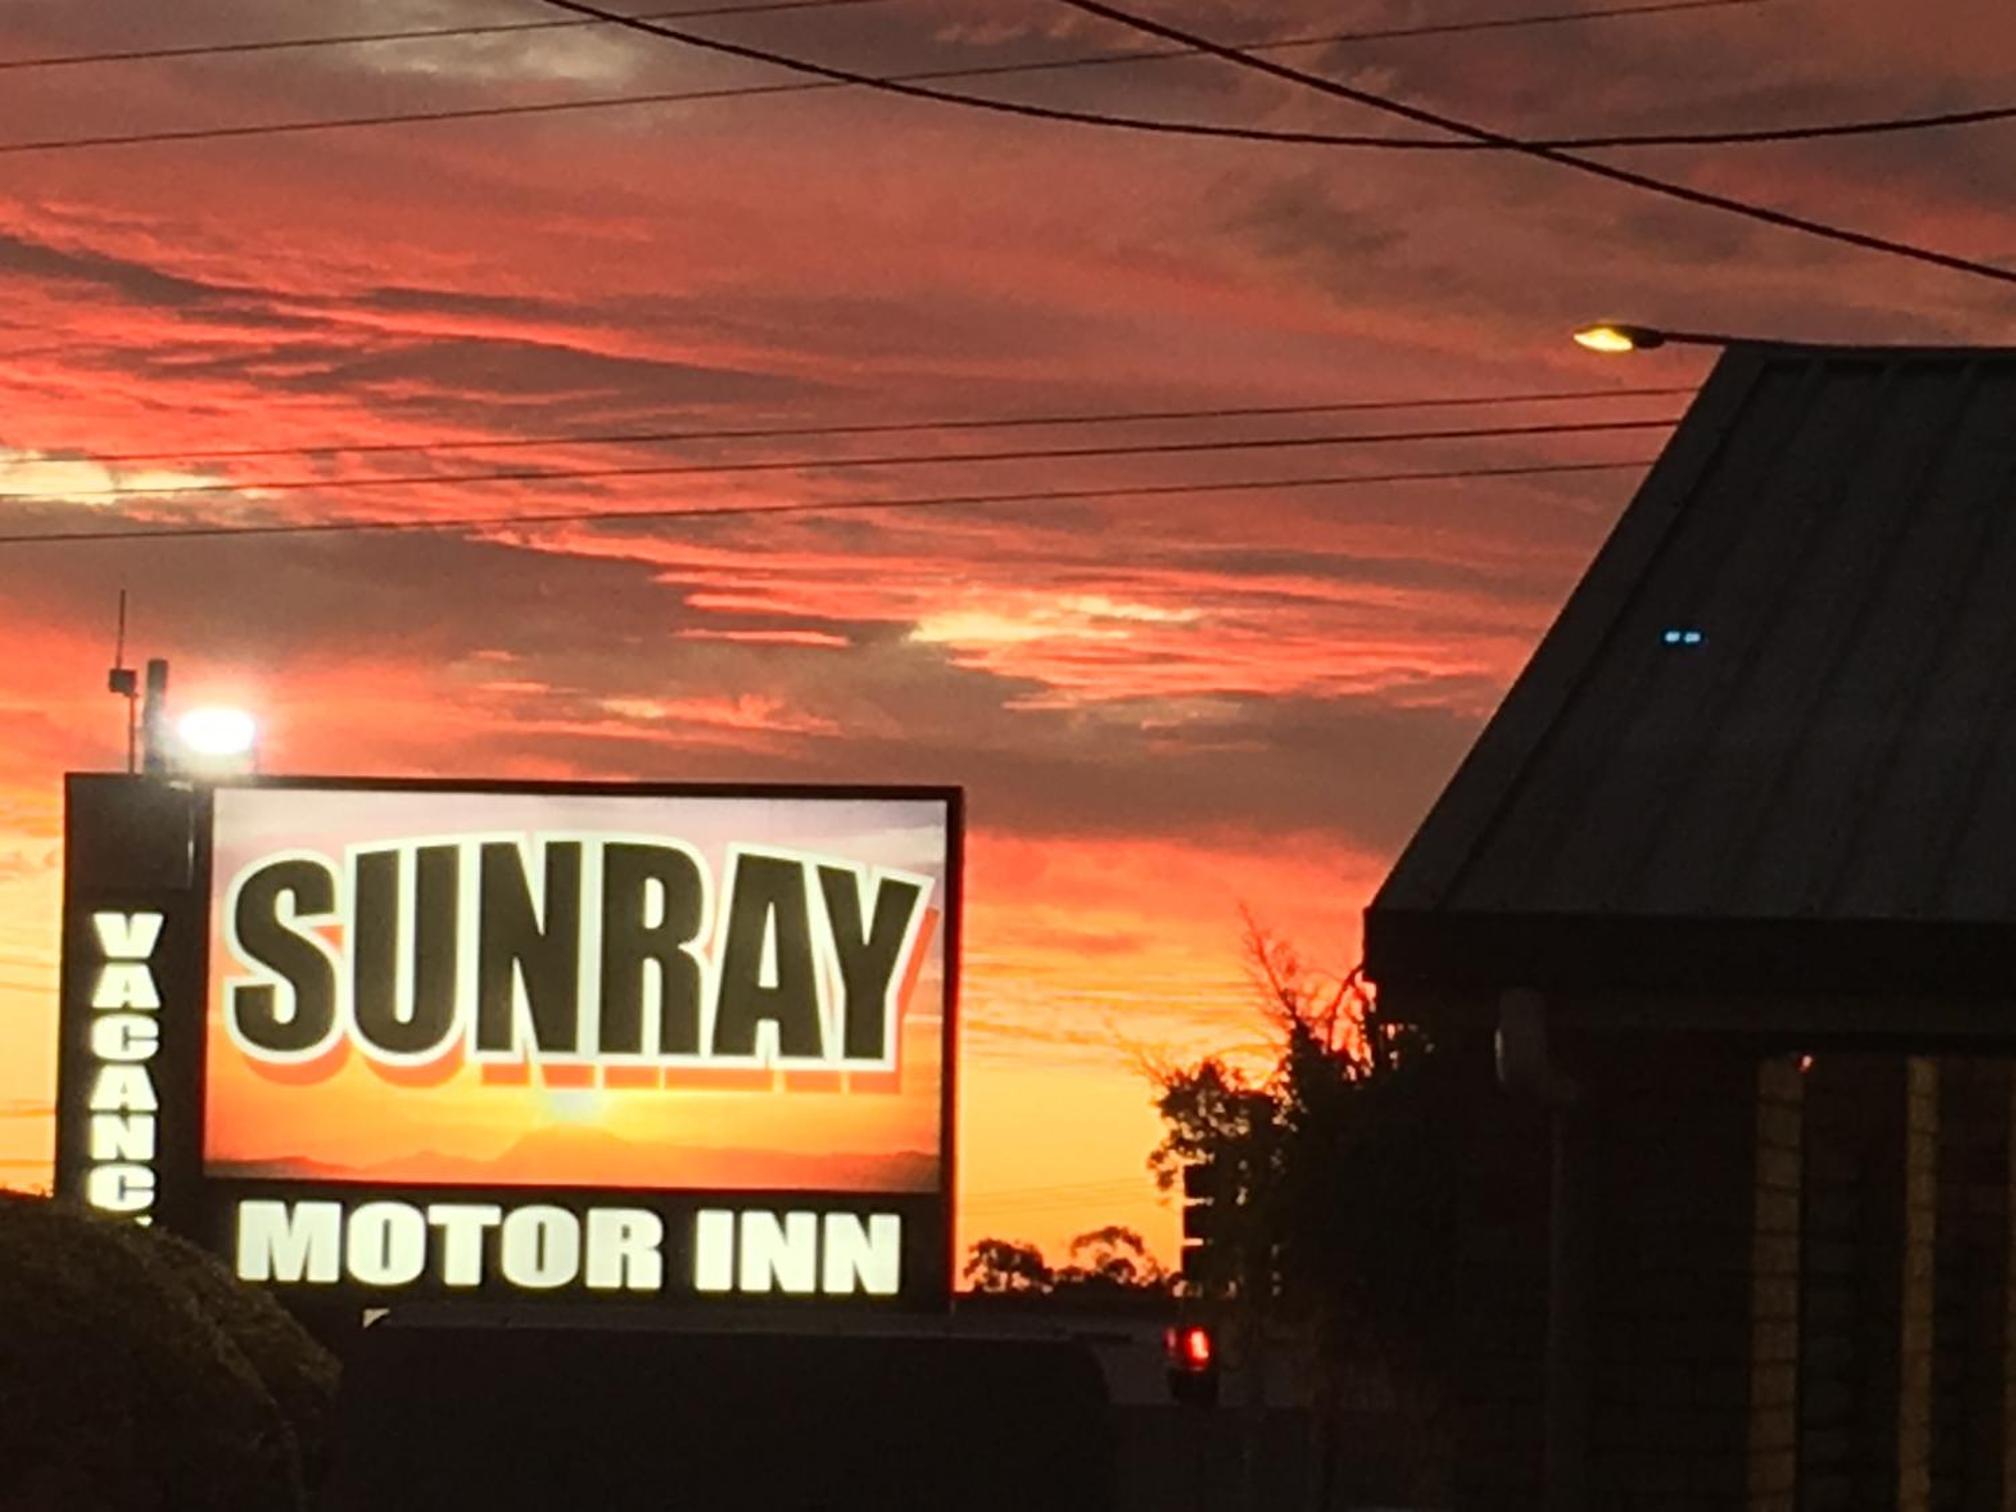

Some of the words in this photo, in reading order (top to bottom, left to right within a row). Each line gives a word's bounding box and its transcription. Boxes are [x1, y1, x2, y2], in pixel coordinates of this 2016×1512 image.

[228, 834, 931, 1067] SUNRAY
[88, 911, 164, 1227] VACANC
[237, 1200, 664, 1291] MOTOR
[694, 1209, 901, 1295] INN
